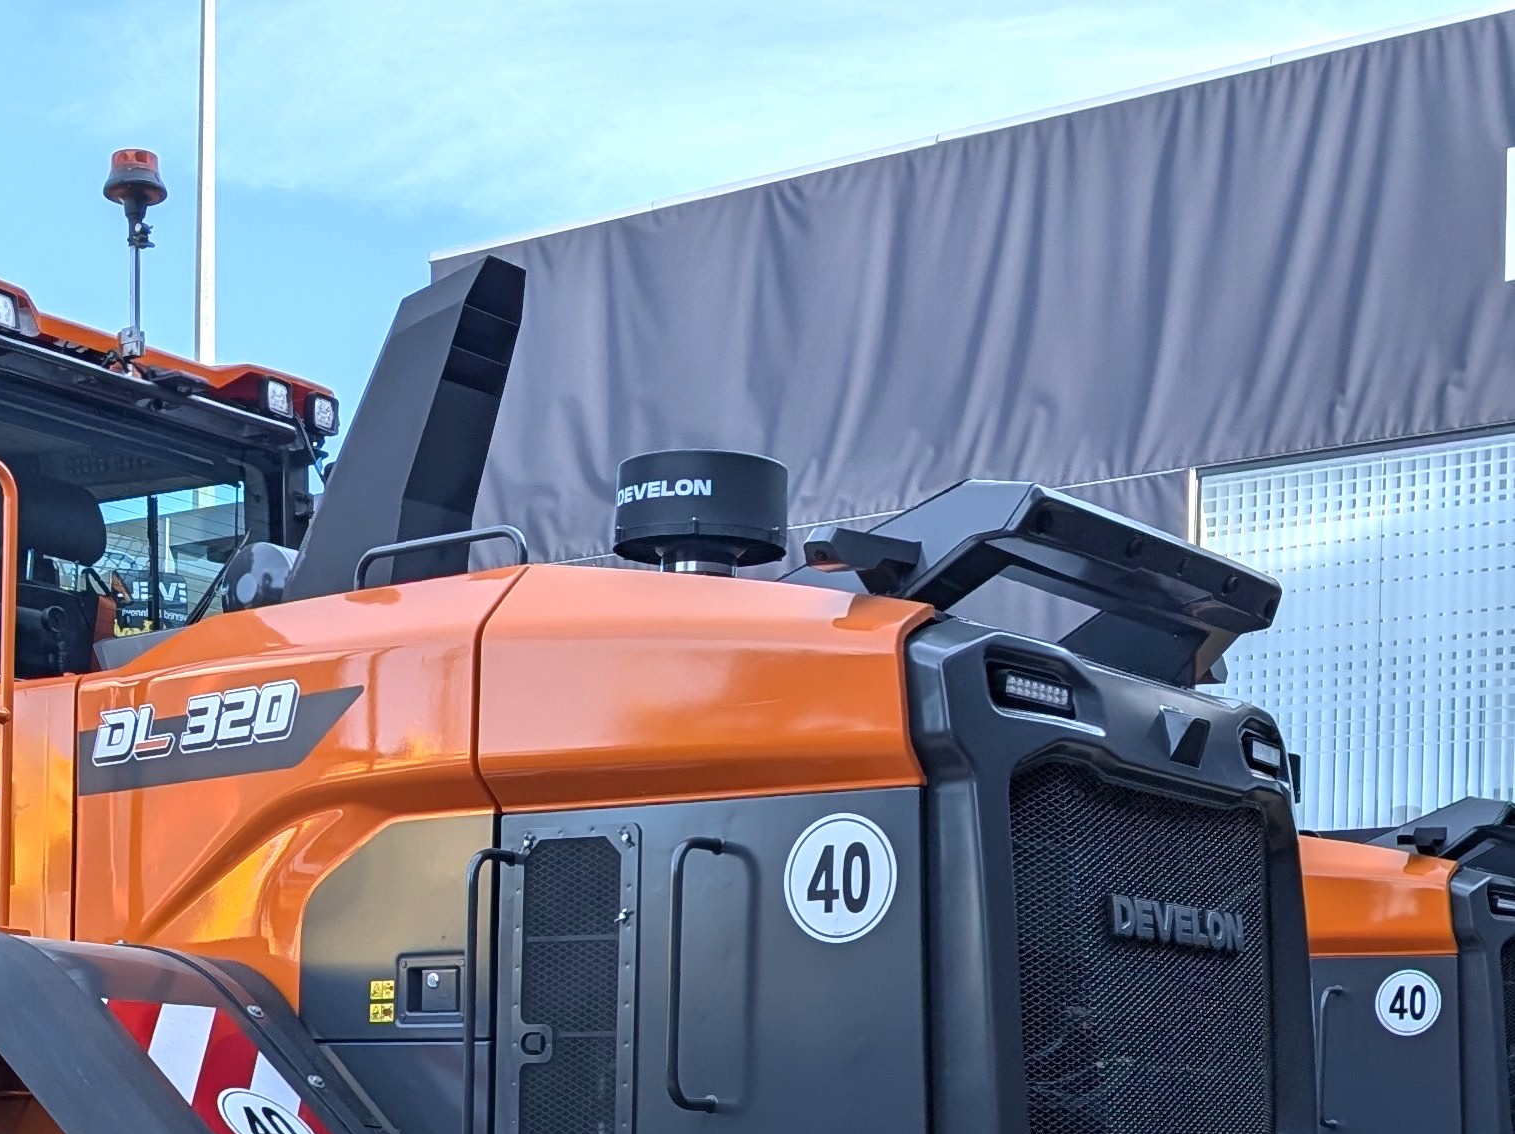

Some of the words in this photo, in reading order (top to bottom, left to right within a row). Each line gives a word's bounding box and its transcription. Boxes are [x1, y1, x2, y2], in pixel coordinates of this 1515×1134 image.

[616, 479, 713, 508] DEVELON
[92, 704, 175, 767] DL
[179, 679, 301, 754] 320
[806, 841, 871, 914] 40
[1111, 894, 1246, 953] DEVELON
[1388, 984, 1427, 1021] 40
